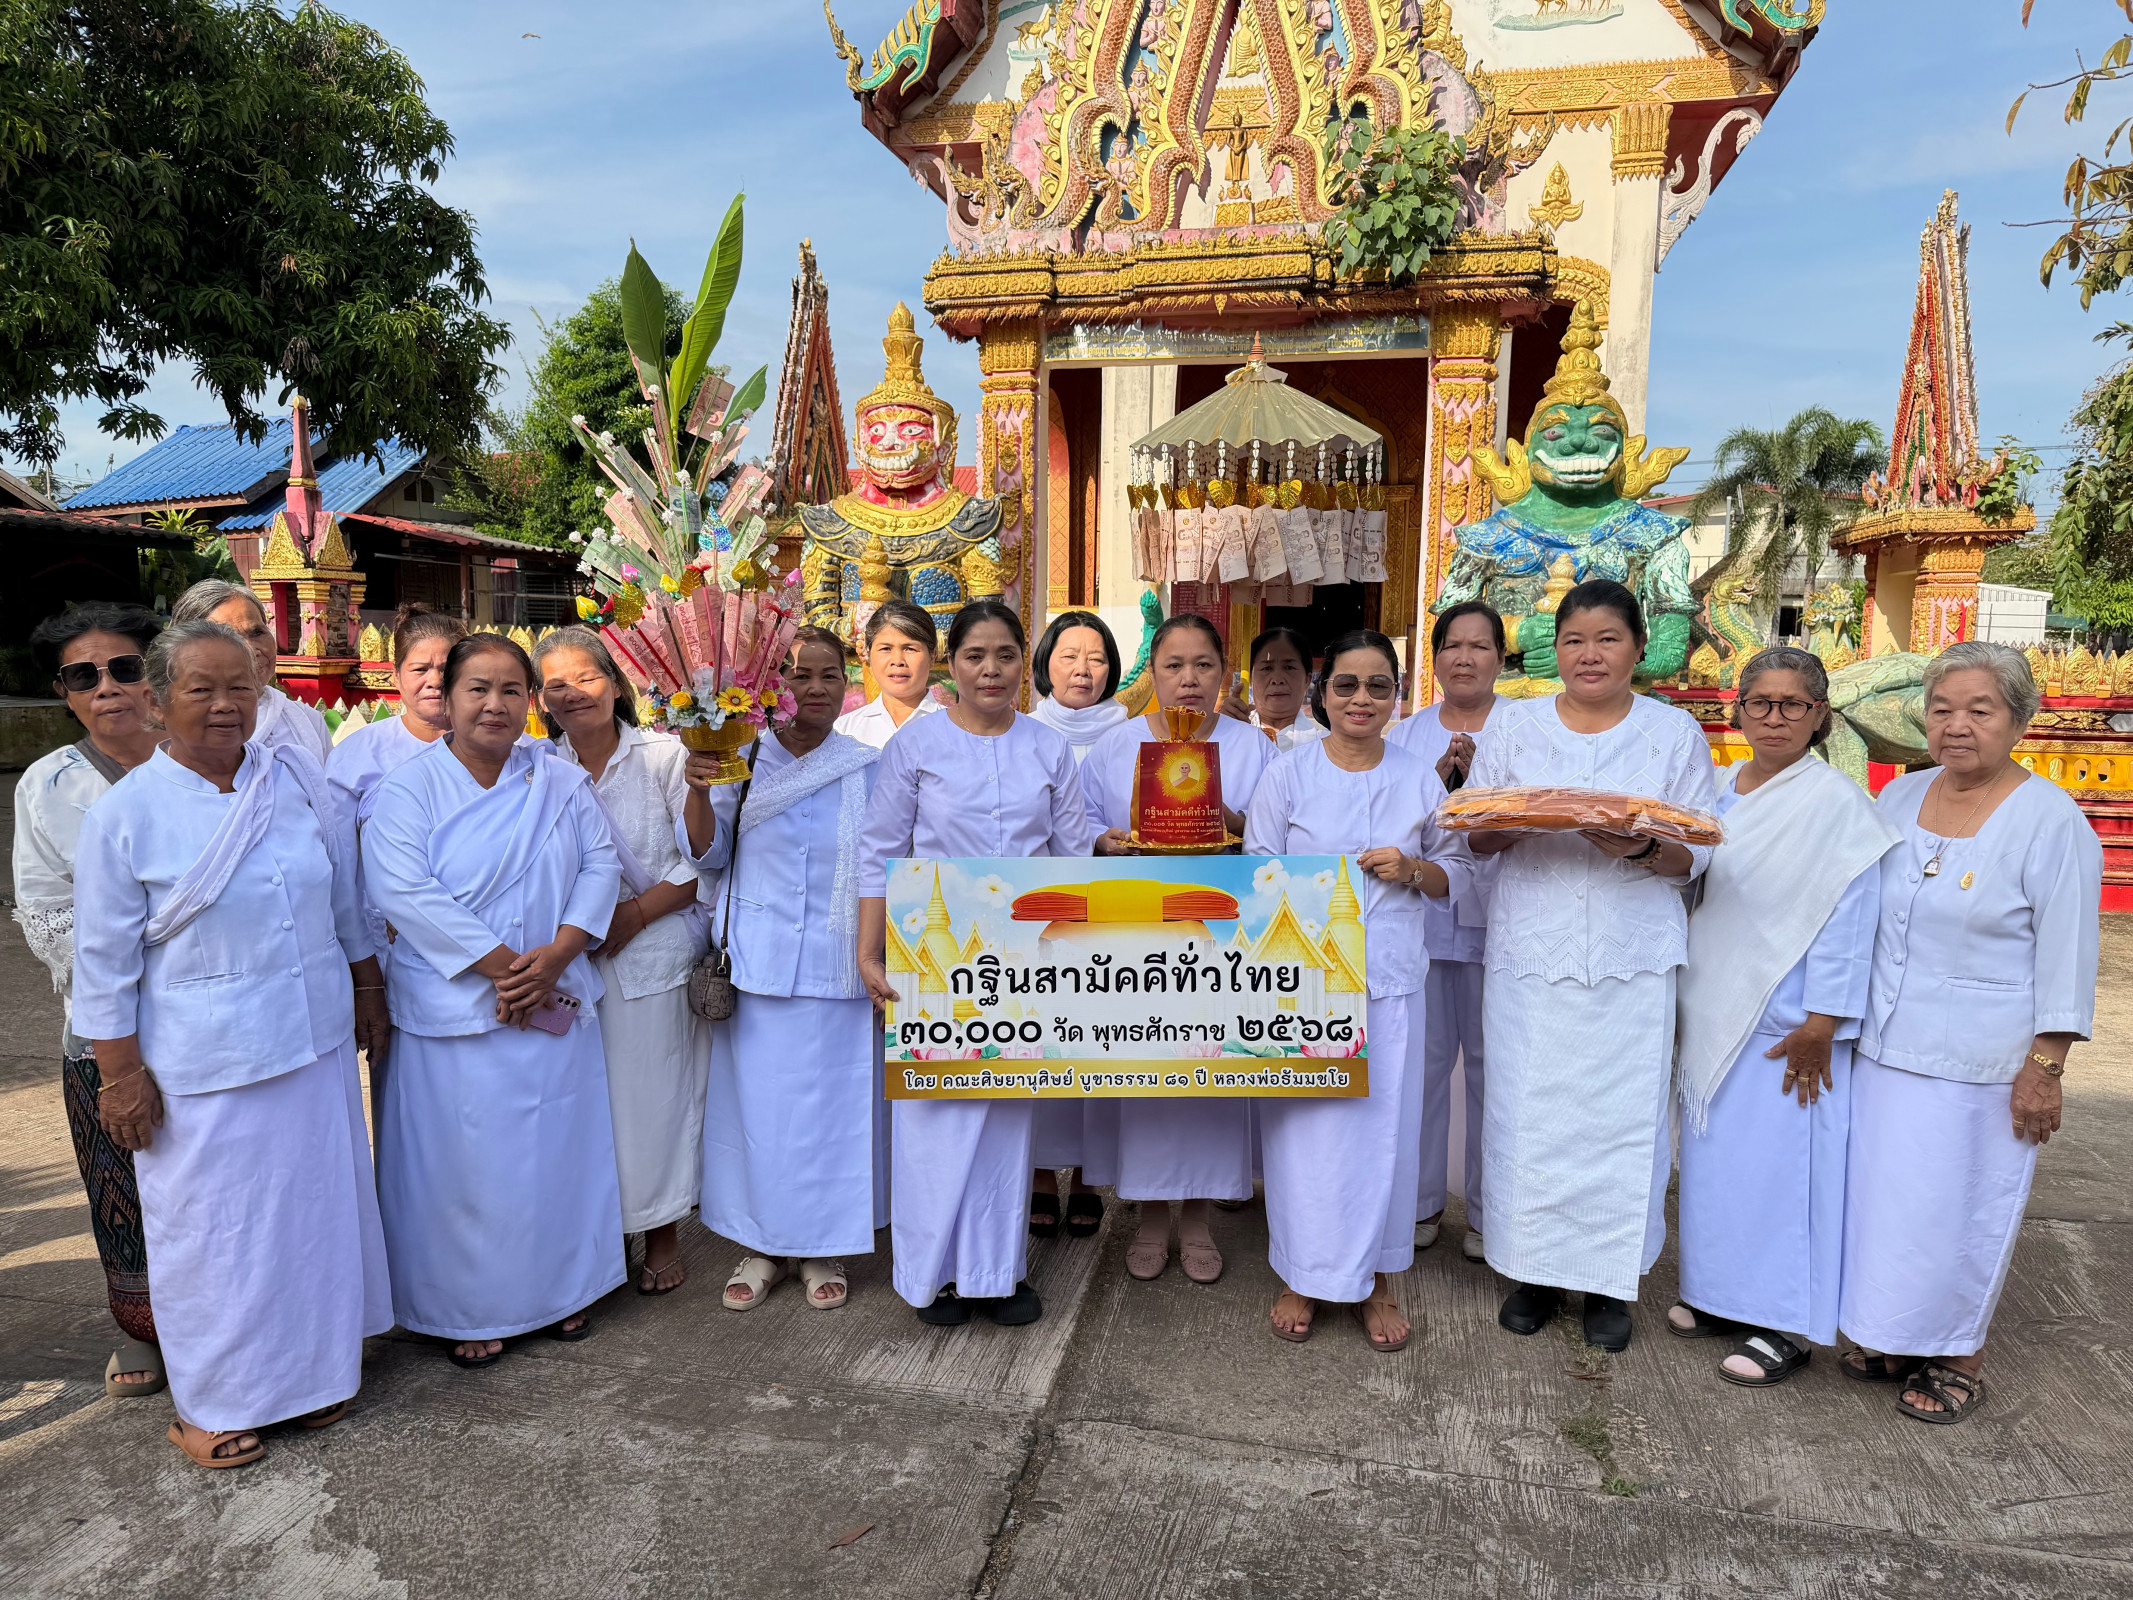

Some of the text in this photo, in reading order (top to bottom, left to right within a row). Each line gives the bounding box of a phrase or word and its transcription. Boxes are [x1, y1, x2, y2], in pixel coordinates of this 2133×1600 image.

[950, 943, 1301, 1006] กฐินสามัคคีทั่วไทย
[901, 1014, 1354, 1052] ๓๐,๐๐๐ วัด พุทธศักราช ๒๕๖๘
[903, 1066, 1351, 1093] โดย คณะศิษยานุศิษย์ บูชาธรรม ๘๑ ปี หลวงพ่อธัมมชโย
